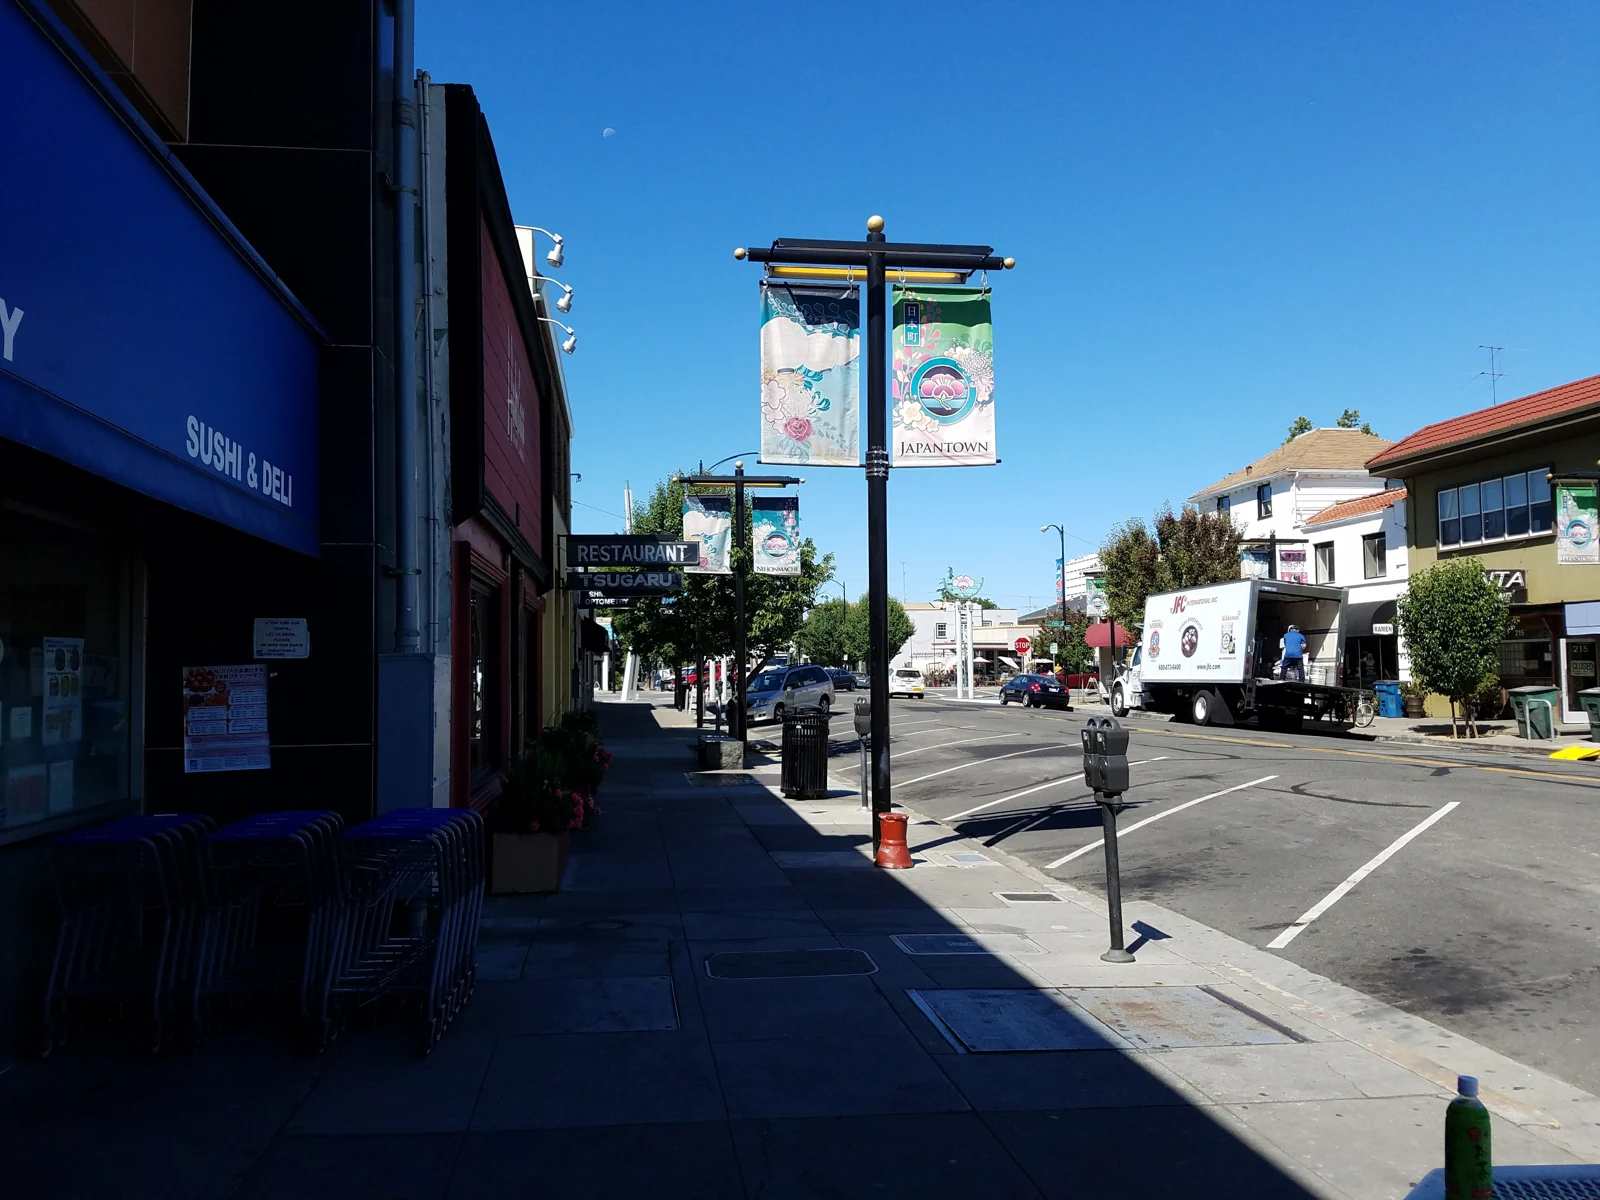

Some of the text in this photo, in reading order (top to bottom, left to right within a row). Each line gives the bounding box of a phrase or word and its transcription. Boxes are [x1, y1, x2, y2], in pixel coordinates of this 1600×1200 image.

[906, 306, 918, 343] 日本町
[900, 441, 989, 458] JAPANTOWN
[186, 415, 292, 508] SUSHI & DELI
[577, 544, 688, 562] RESTAURANT
[578, 573, 673, 588] TSUGARU
[1169, 594, 1187, 614] JFC
[1374, 625, 1393, 633] RAMEN
[1514, 629, 1525, 637] 215
[1015, 641, 1030, 649] STOP
[1573, 645, 1589, 653] 215
[1572, 661, 1594, 671] CLOSED
